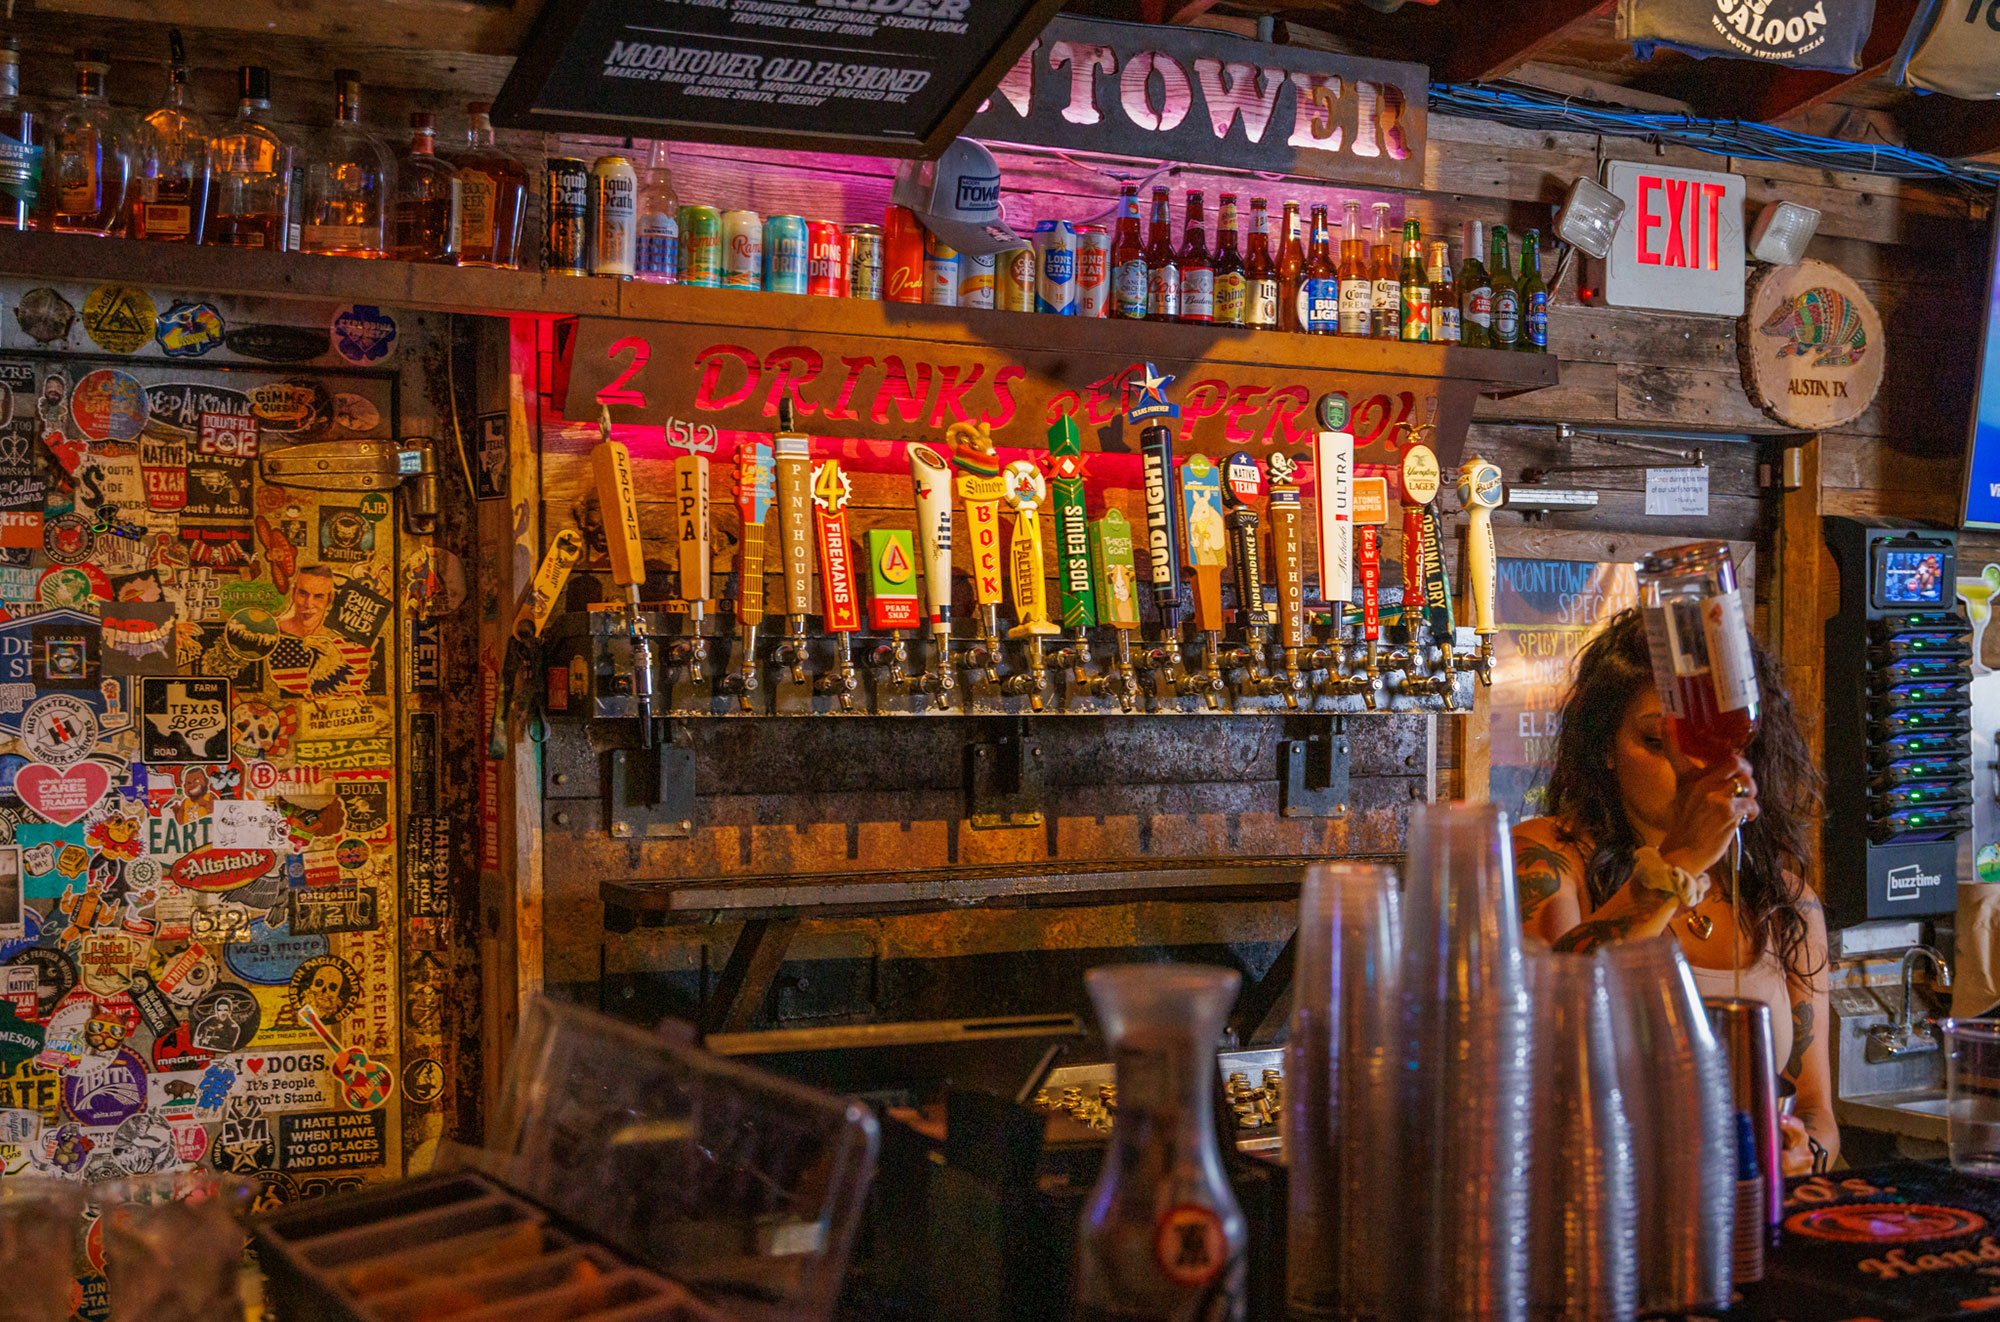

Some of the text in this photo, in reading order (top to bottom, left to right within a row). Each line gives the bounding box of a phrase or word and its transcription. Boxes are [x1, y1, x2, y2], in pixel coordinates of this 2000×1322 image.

[730, 0, 815, 18] STRAWBERRY
[814, 8, 881, 26] LEMONADE
[1717, 0, 1828, 45] SALOON
[730, 12, 879, 37] TROPICAL ENERGY DRINK
[1712, 14, 1728, 35] WAY
[1726, 33, 1753, 54] SOUTH
[1798, 35, 1825, 55] TEXAS
[604, 40, 931, 93] MOONTOWER OLD FASHIONED
[603, 66, 662, 81] MAKER'S
[660, 72, 701, 85] MARK
[759, 80, 836, 98] MOONTOWER
[834, 88, 886, 102] INFUSED
[683, 85, 734, 99] ORANGE
[777, 94, 827, 107] CHERRY
[1636, 175, 1725, 271] EXIT
[814, 243, 841, 261] LONG
[1047, 255, 1071, 265] LONE
[1047, 264, 1071, 275] STAR
[596, 337, 651, 407] 2
[694, 344, 1027, 430] DRINKS
[1787, 378, 1848, 398] AUSTIN, TX
[203, 414, 258, 432] DOWNFALL
[1131, 407, 1147, 418] TEXAS
[665, 416, 717, 453] (512)
[142, 444, 186, 465] NATIVE
[144, 470, 186, 493] TEXAN
[1232, 467, 1257, 481] NATIVE
[1336, 451, 1348, 509] ULTRA
[616, 451, 637, 541] PECAN
[814, 459, 846, 514] 4
[965, 478, 1004, 496] Shiner
[1234, 481, 1258, 495] TEXAN
[1408, 481, 1436, 491] LAGER
[214, 503, 250, 515] Austin
[361, 501, 388, 515] AJH
[680, 471, 697, 542] IPA
[1144, 453, 1171, 584] BUD LIGHT
[791, 463, 807, 609] PINTHOUSE
[975, 504, 998, 597] BOCK
[1065, 504, 1090, 592] DOS EQUIS
[1108, 546, 1129, 556] GOAT
[826, 522, 850, 604] FIREMANS
[1247, 536, 1262, 612] INDEPENDENCE
[1285, 513, 1301, 642] PINTHOUSE
[1364, 530, 1378, 635] NEW BELGIUM
[1499, 561, 1602, 593] MOONTOWER
[348, 589, 385, 616] BUILT
[1427, 579, 1447, 609] DRY
[885, 604, 911, 613] PEARL
[887, 611, 911, 620] SNAP
[1516, 632, 1559, 657] SPICY
[419, 624, 438, 687] YETI
[1520, 658, 1565, 685] LONG
[194, 683, 218, 692] FARM
[27, 699, 82, 735] AUSTIN TEXAS
[169, 703, 220, 715] TEXAS
[168, 714, 221, 730] Beer
[1518, 712, 1542, 738] EL
[34, 719, 96, 764] BINDER DRIVERS
[191, 732, 207, 742] CO.
[153, 748, 178, 757] ROAD
[296, 738, 391, 759] BRIAN
[38, 783, 77, 794] CARE
[341, 783, 382, 796] BUDA
[40, 798, 87, 807] TRAUMA
[187, 851, 261, 877] Altstadt
[1891, 873, 1938, 889] buzztime
[299, 889, 357, 901] patagonia
[419, 878, 433, 914] ROLL
[81, 952, 134, 965] Hearted
[91, 942, 126, 955] Light
[234, 939, 319, 957] wag more
[97, 964, 120, 977] Ale
[304, 956, 343, 969] FACIAL
[343, 963, 361, 994] HAIR
[9, 980, 36, 994] NATIVE
[138, 994, 160, 1022] BREWING
[146, 989, 169, 1018] BIG BEND
[372, 982, 389, 1050] SEEING
[157, 1054, 213, 1066] MAGPUL
[235, 1054, 331, 1076] I DOGS.
[74, 1066, 137, 1107] ABITA
[245, 1077, 317, 1092] It's People
[282, 1091, 327, 1105] Stand.
[92, 1110, 124, 1119] abita.com
[294, 1114, 372, 1129] I HATE DAYS
[290, 1126, 376, 1143] WHEN I HAVE
[287, 1139, 379, 1156] TO GO PLACES
[286, 1151, 380, 1169] AND DO STUFF
